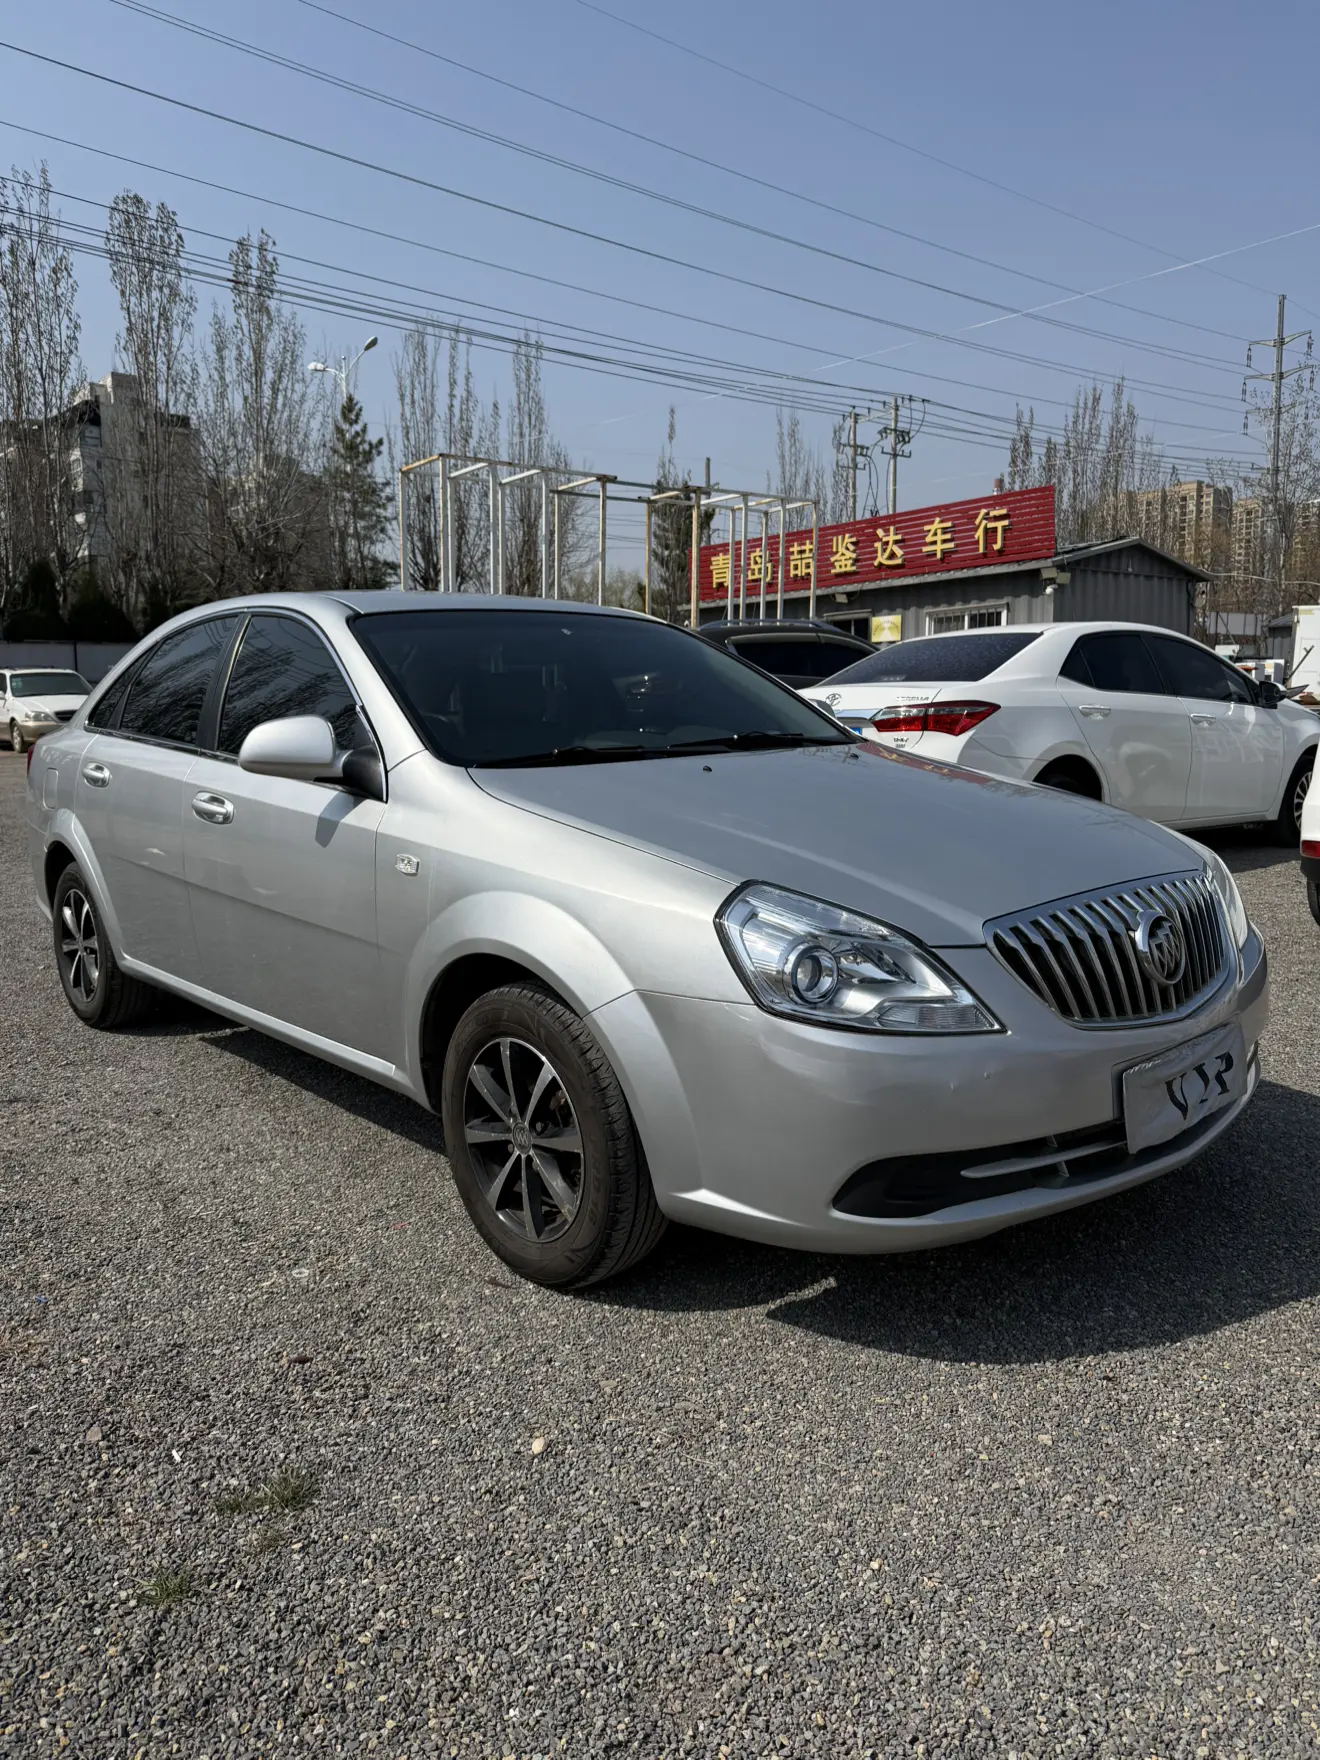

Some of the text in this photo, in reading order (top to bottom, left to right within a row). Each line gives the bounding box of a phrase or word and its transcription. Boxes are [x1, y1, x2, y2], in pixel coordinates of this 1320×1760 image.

[709, 508, 1010, 589] 青岛喆鉴达车行
